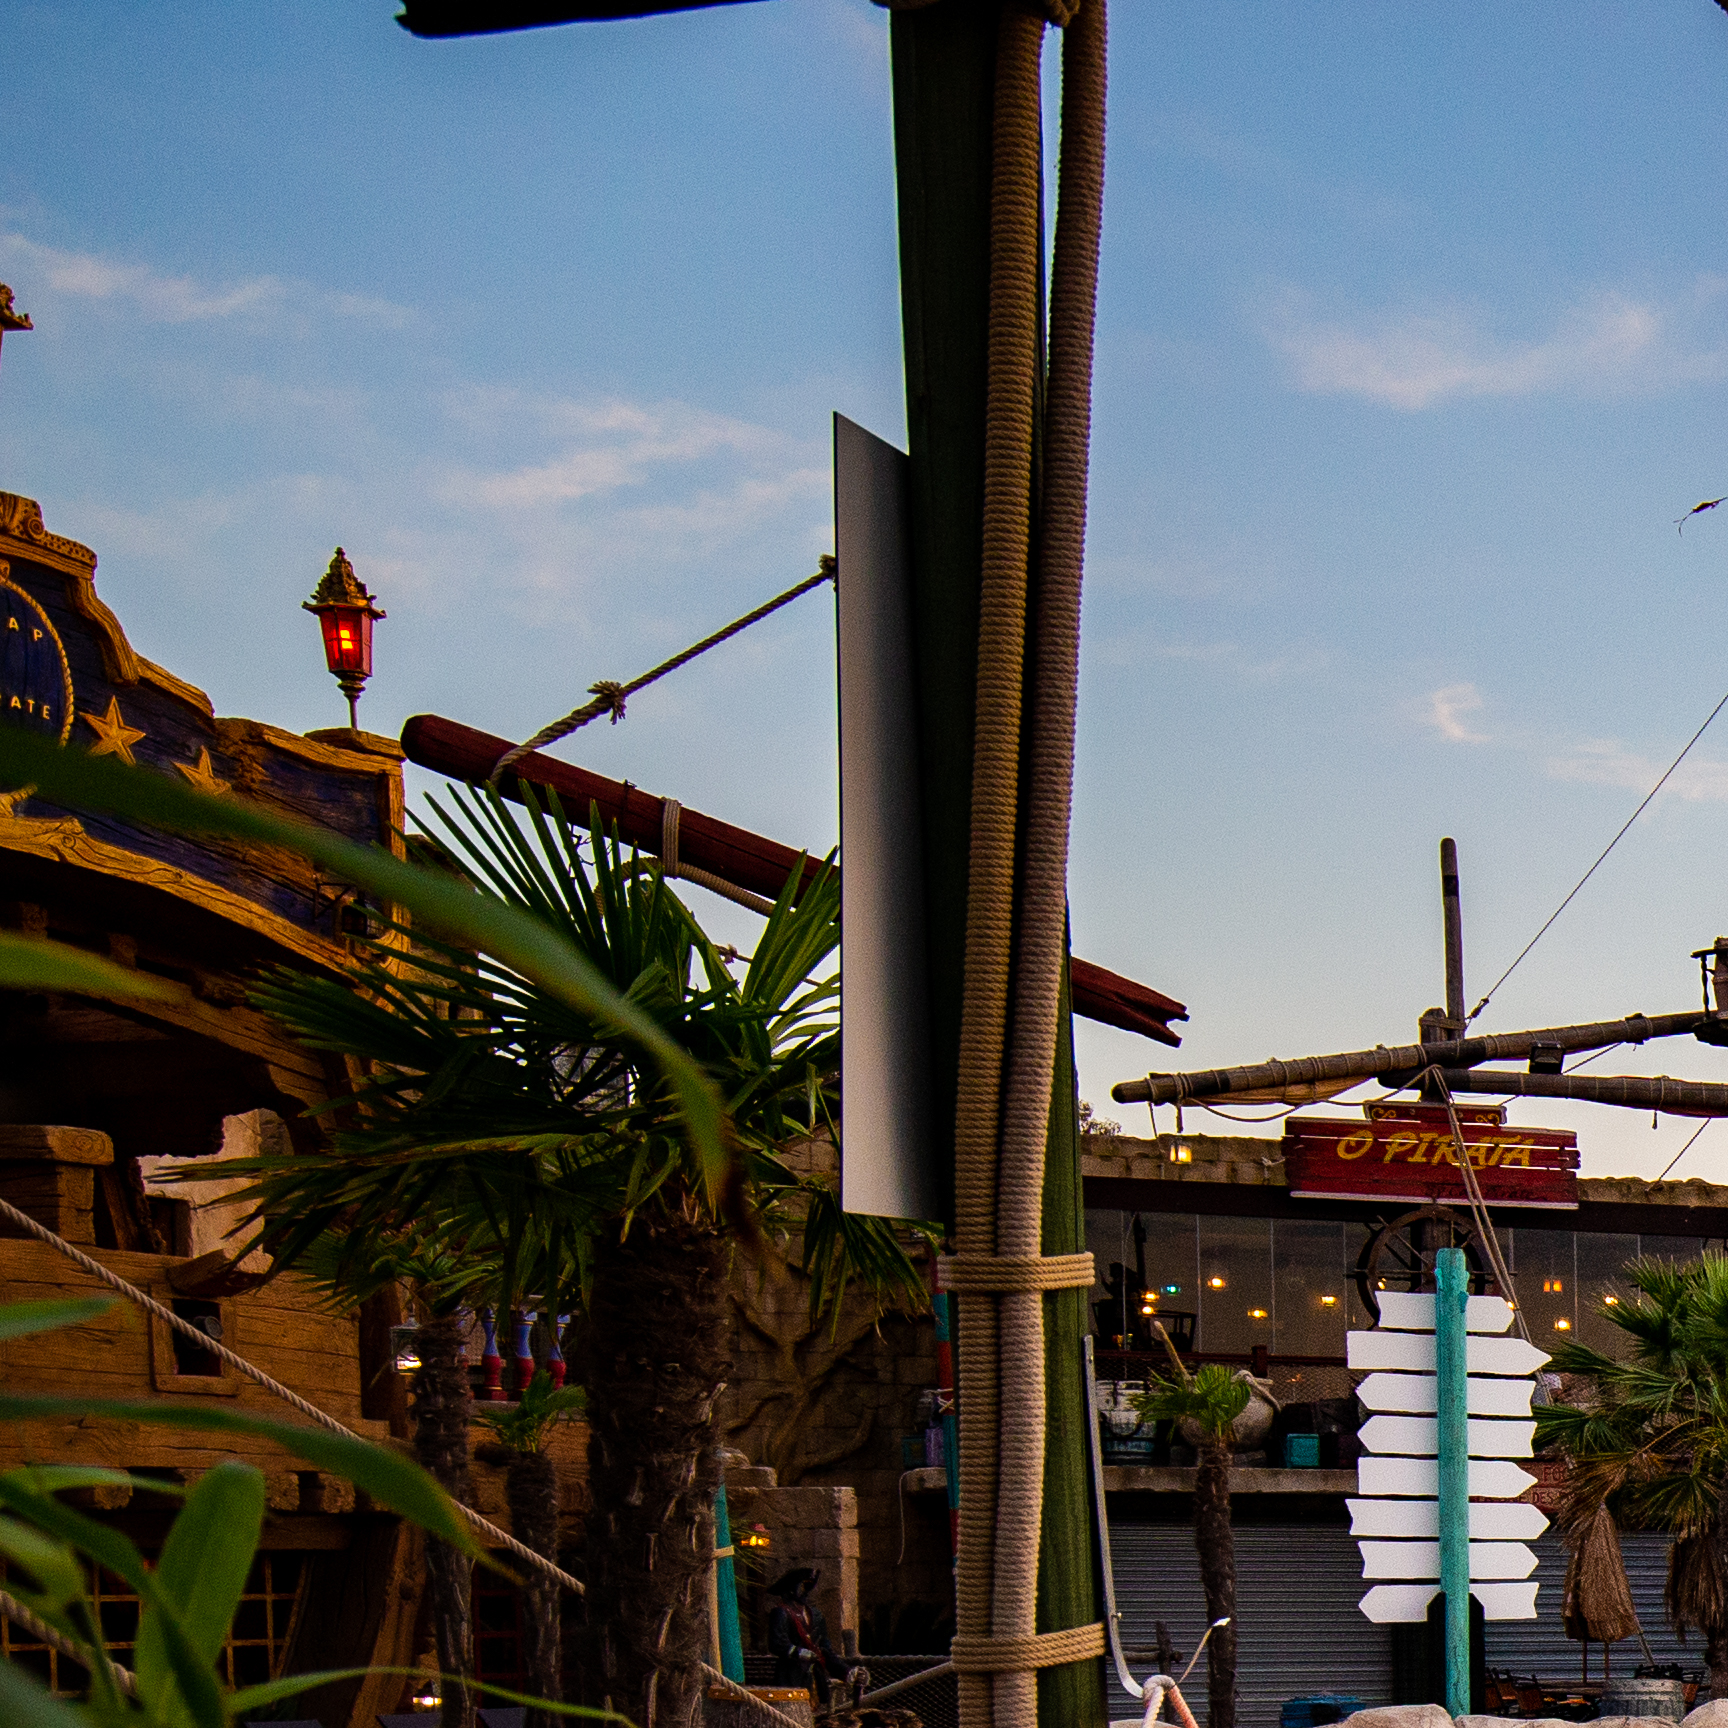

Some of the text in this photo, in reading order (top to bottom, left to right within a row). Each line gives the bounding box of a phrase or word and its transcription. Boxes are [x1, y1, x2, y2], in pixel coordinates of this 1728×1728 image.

[8, 617, 43, 641] AP
[0, 694, 51, 720] ATE
[1336, 1129, 1535, 1170] O PIRATA
